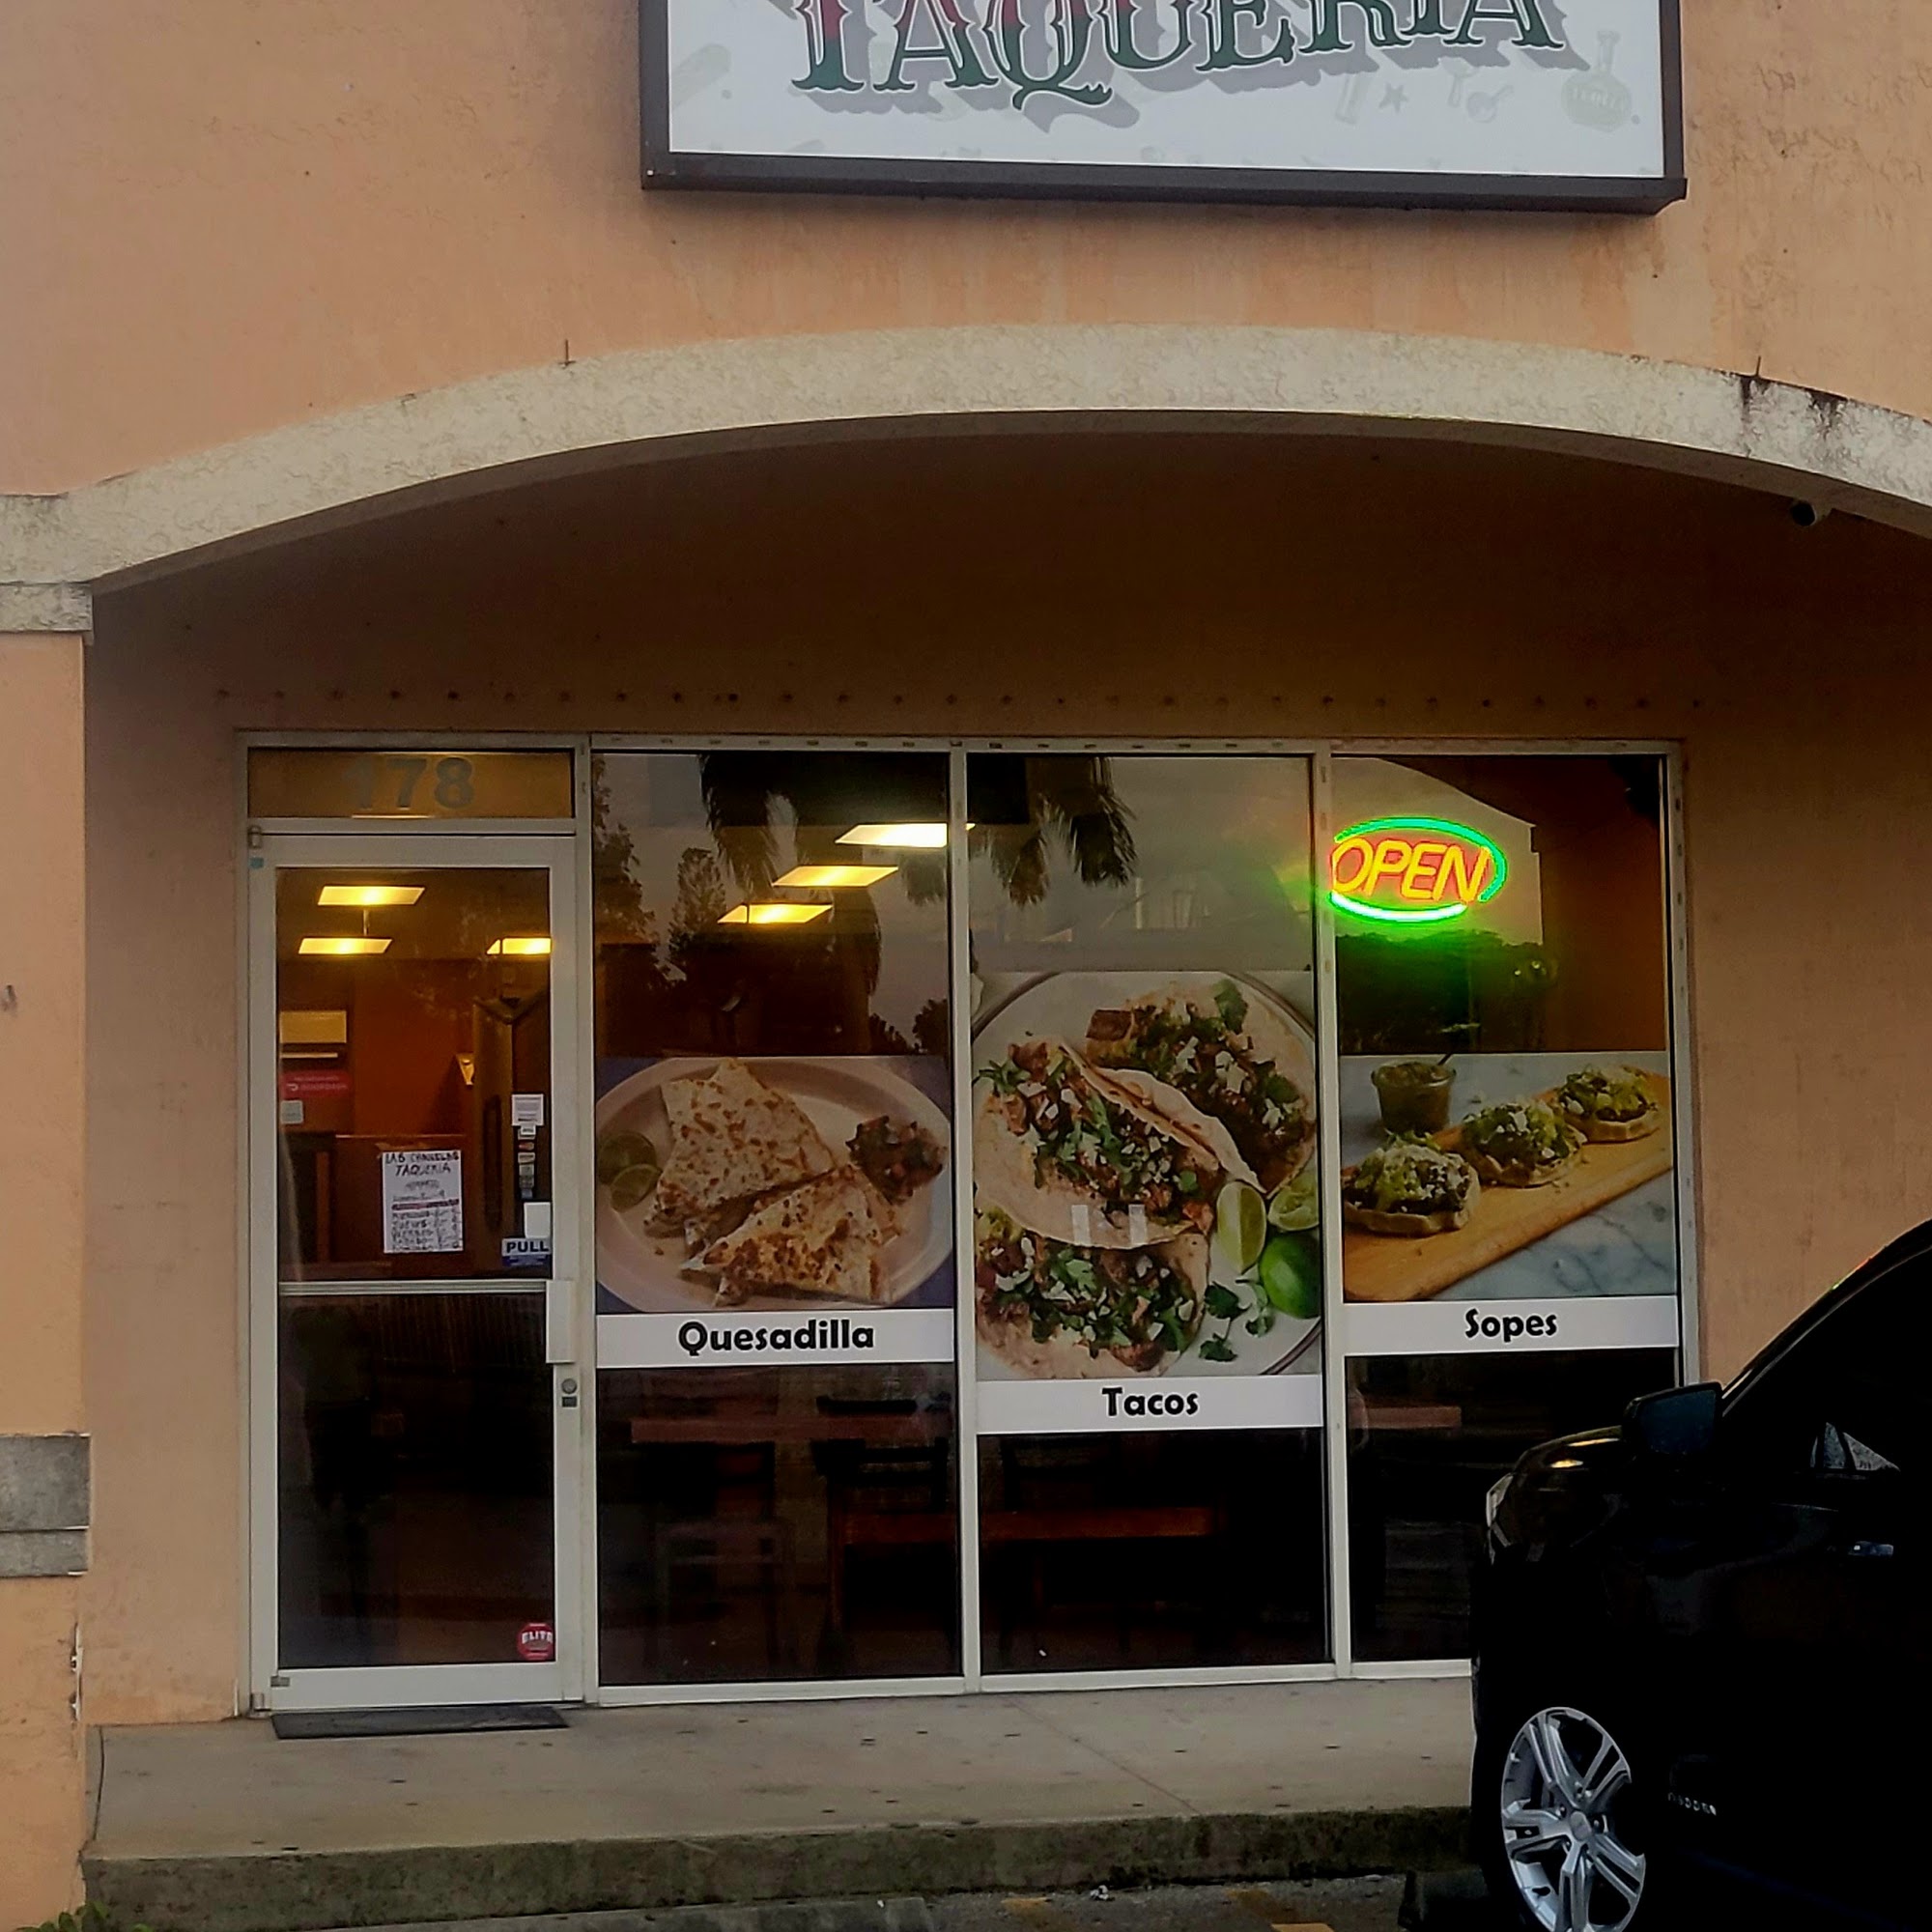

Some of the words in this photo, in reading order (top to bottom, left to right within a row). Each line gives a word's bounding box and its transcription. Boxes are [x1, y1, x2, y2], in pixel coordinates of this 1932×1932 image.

[792, 0, 1565, 111] TAQUE
[344, 757, 474, 809] 178
[1331, 837, 1491, 902] OPEN
[506, 1240, 550, 1254] PULL
[678, 1320, 873, 1356] Quesadilla
[1465, 1308, 1557, 1343] Sopes
[1102, 1386, 1199, 1416] Tacos
